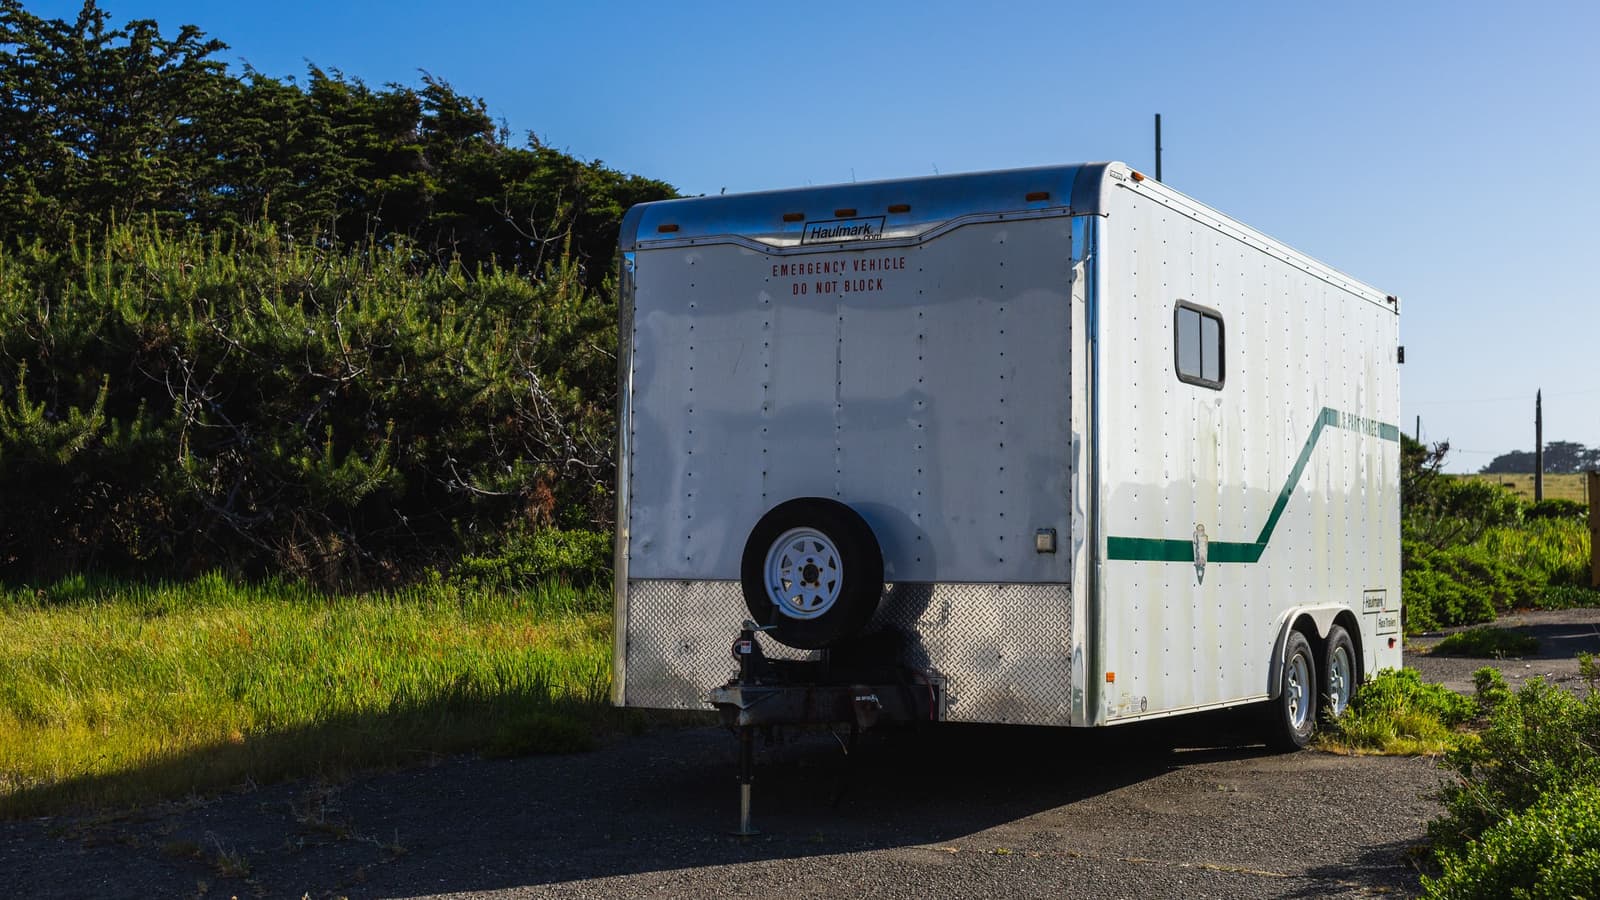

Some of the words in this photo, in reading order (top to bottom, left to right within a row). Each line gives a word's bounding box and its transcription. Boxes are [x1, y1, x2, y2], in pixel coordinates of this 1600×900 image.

[811, 223, 872, 240] Haulmark
[772, 259, 846, 277] EMERGENCY
[853, 256, 906, 272] VEHICLE
[792, 282, 808, 296] DO
[815, 280, 838, 294] NOT
[844, 278, 884, 293] BLOCK
